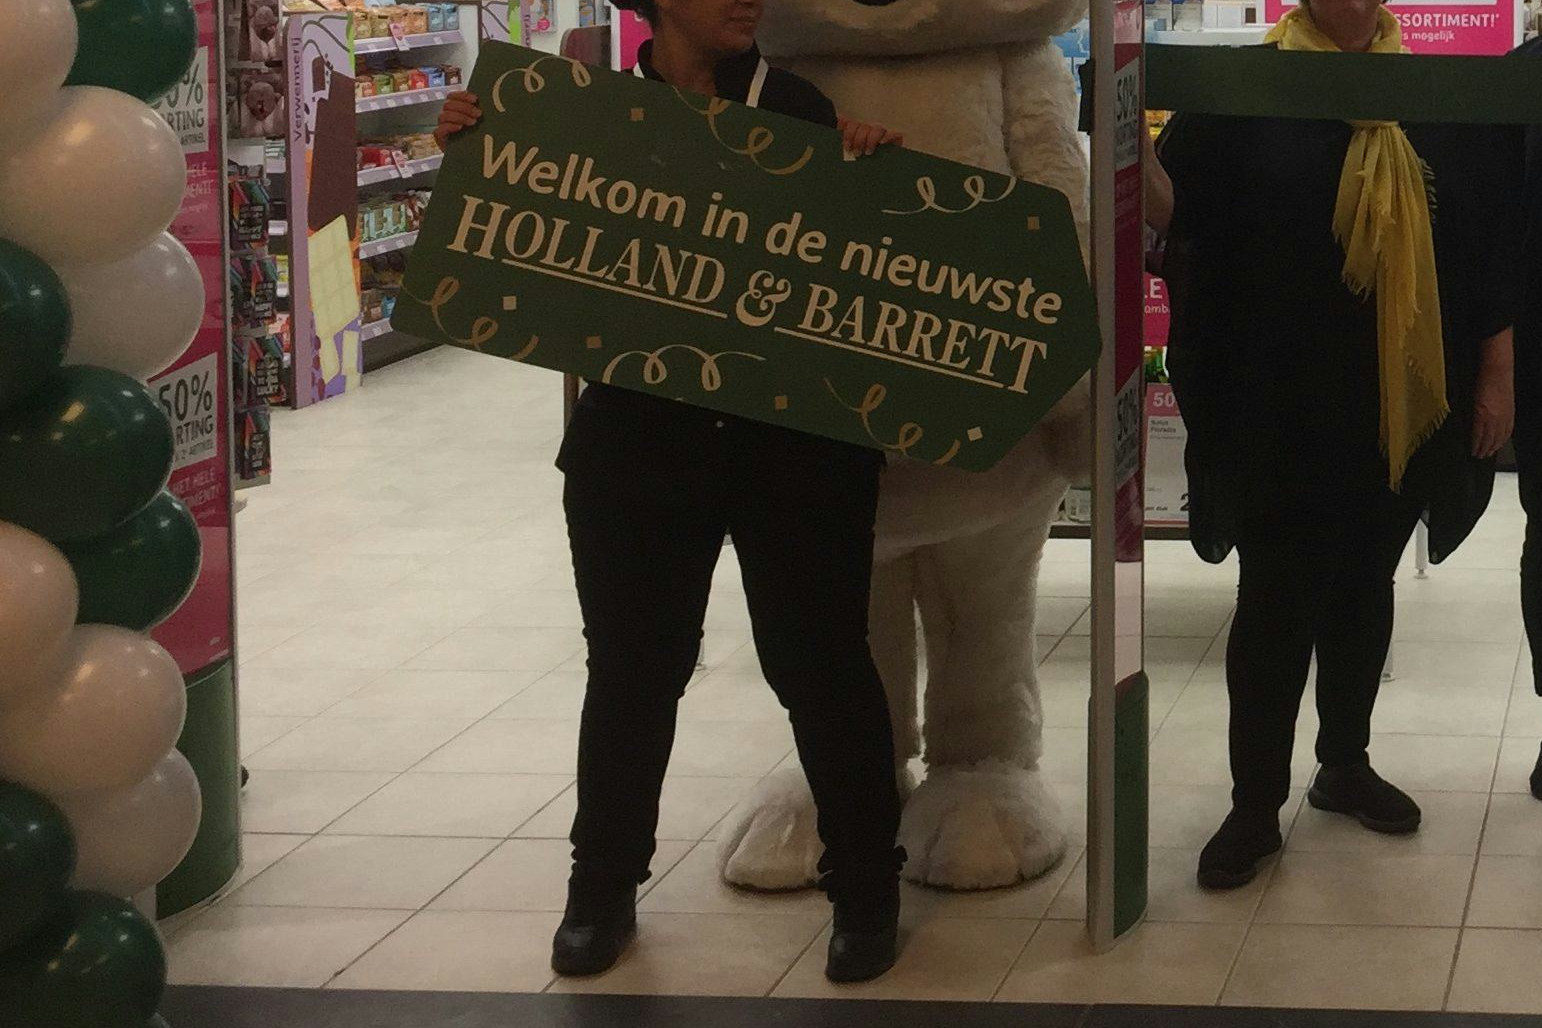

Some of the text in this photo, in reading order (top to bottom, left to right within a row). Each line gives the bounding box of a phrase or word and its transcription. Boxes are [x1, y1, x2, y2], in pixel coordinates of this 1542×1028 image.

[1412, 31, 1455, 43] mogelijk
[161, 109, 205, 132] RTING
[481, 133, 1063, 326] Welkom in de nieuwste
[446, 194, 1048, 395] HOLLAND & BARRETT
[1152, 392, 1176, 408] 50
[176, 416, 213, 446] RTING
